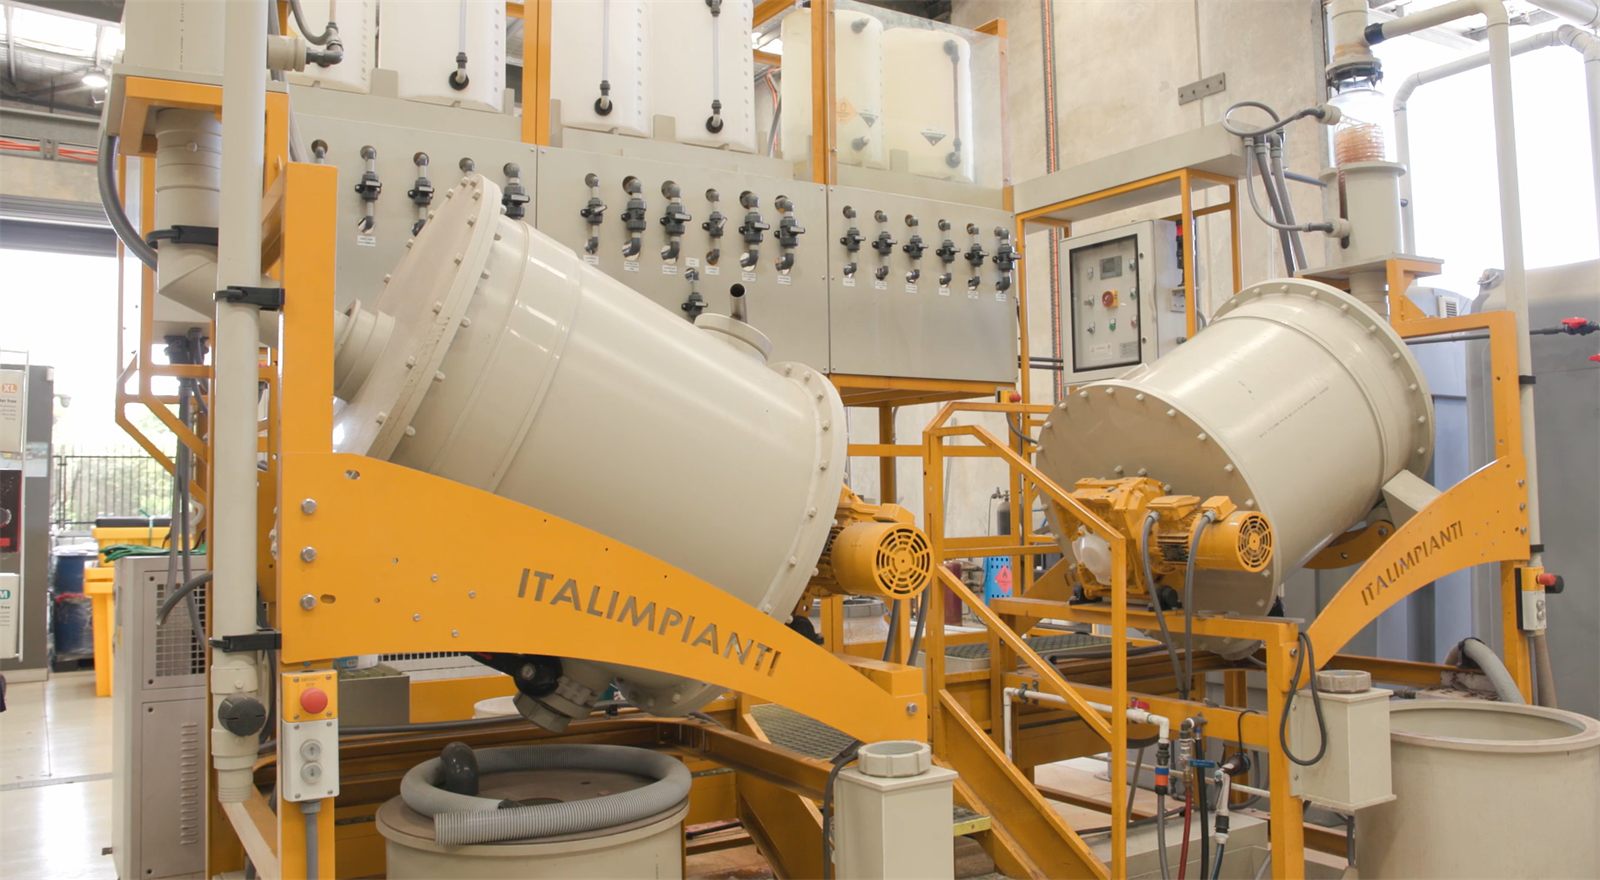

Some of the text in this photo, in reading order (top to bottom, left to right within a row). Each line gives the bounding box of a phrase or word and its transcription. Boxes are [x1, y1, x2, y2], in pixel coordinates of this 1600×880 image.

[3, 384, 17, 393] XL
[1361, 520, 1464, 606] ITALIMPIANTI
[516, 567, 782, 677] ITALIMPIANTI
